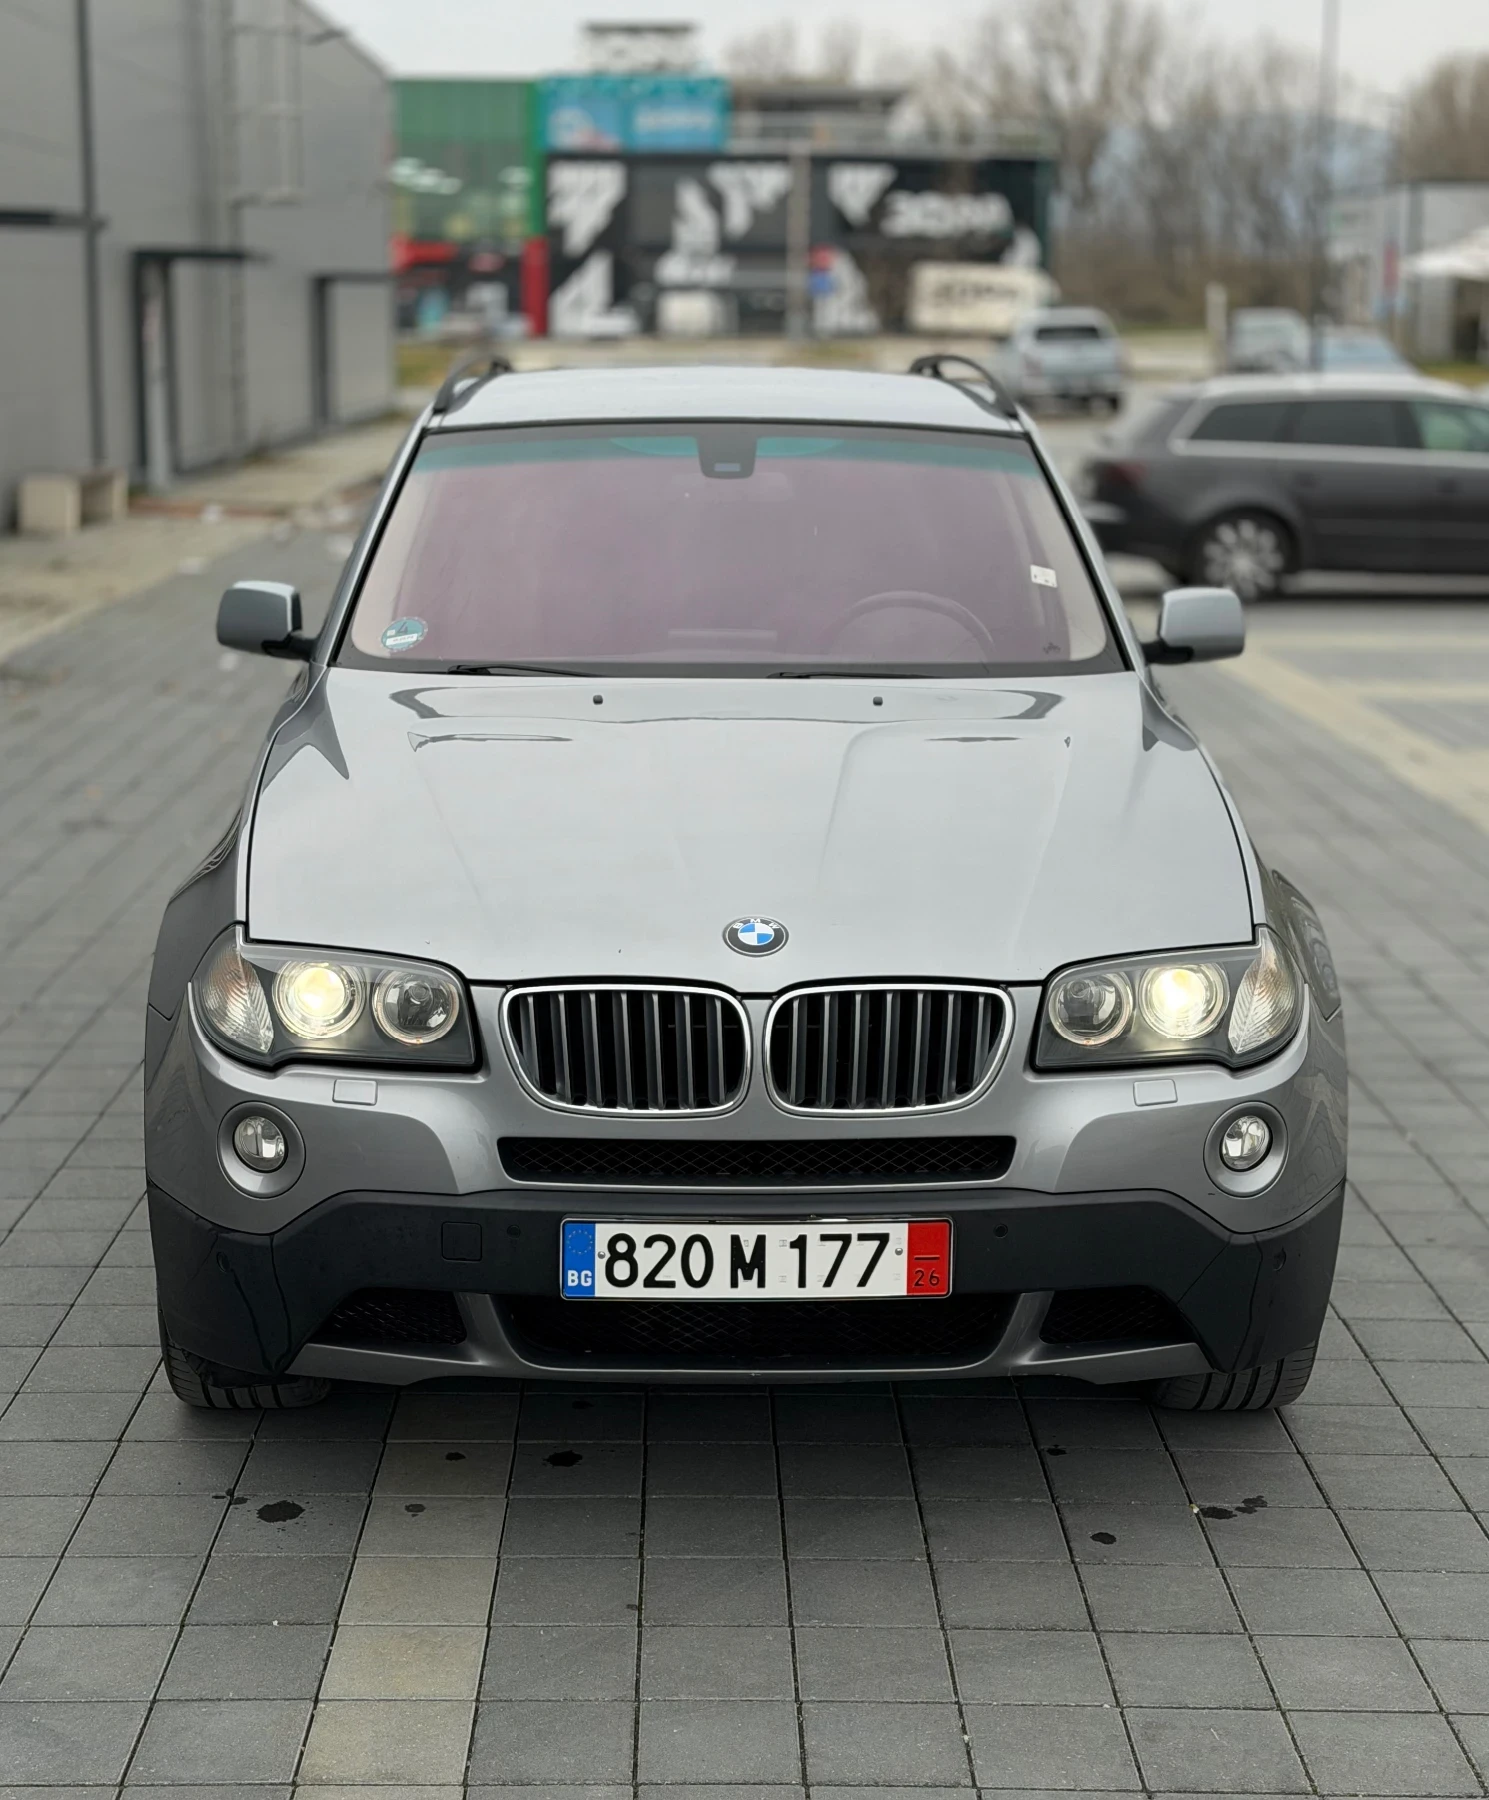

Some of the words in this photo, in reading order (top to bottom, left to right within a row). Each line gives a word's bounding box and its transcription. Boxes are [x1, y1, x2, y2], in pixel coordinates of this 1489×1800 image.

[732, 918, 781, 929] BMW
[604, 1232, 714, 1289] 820
[730, 1234, 766, 1289] M
[789, 1232, 890, 1289] 177
[567, 1269, 593, 1287] BG
[914, 1268, 940, 1287] 26
